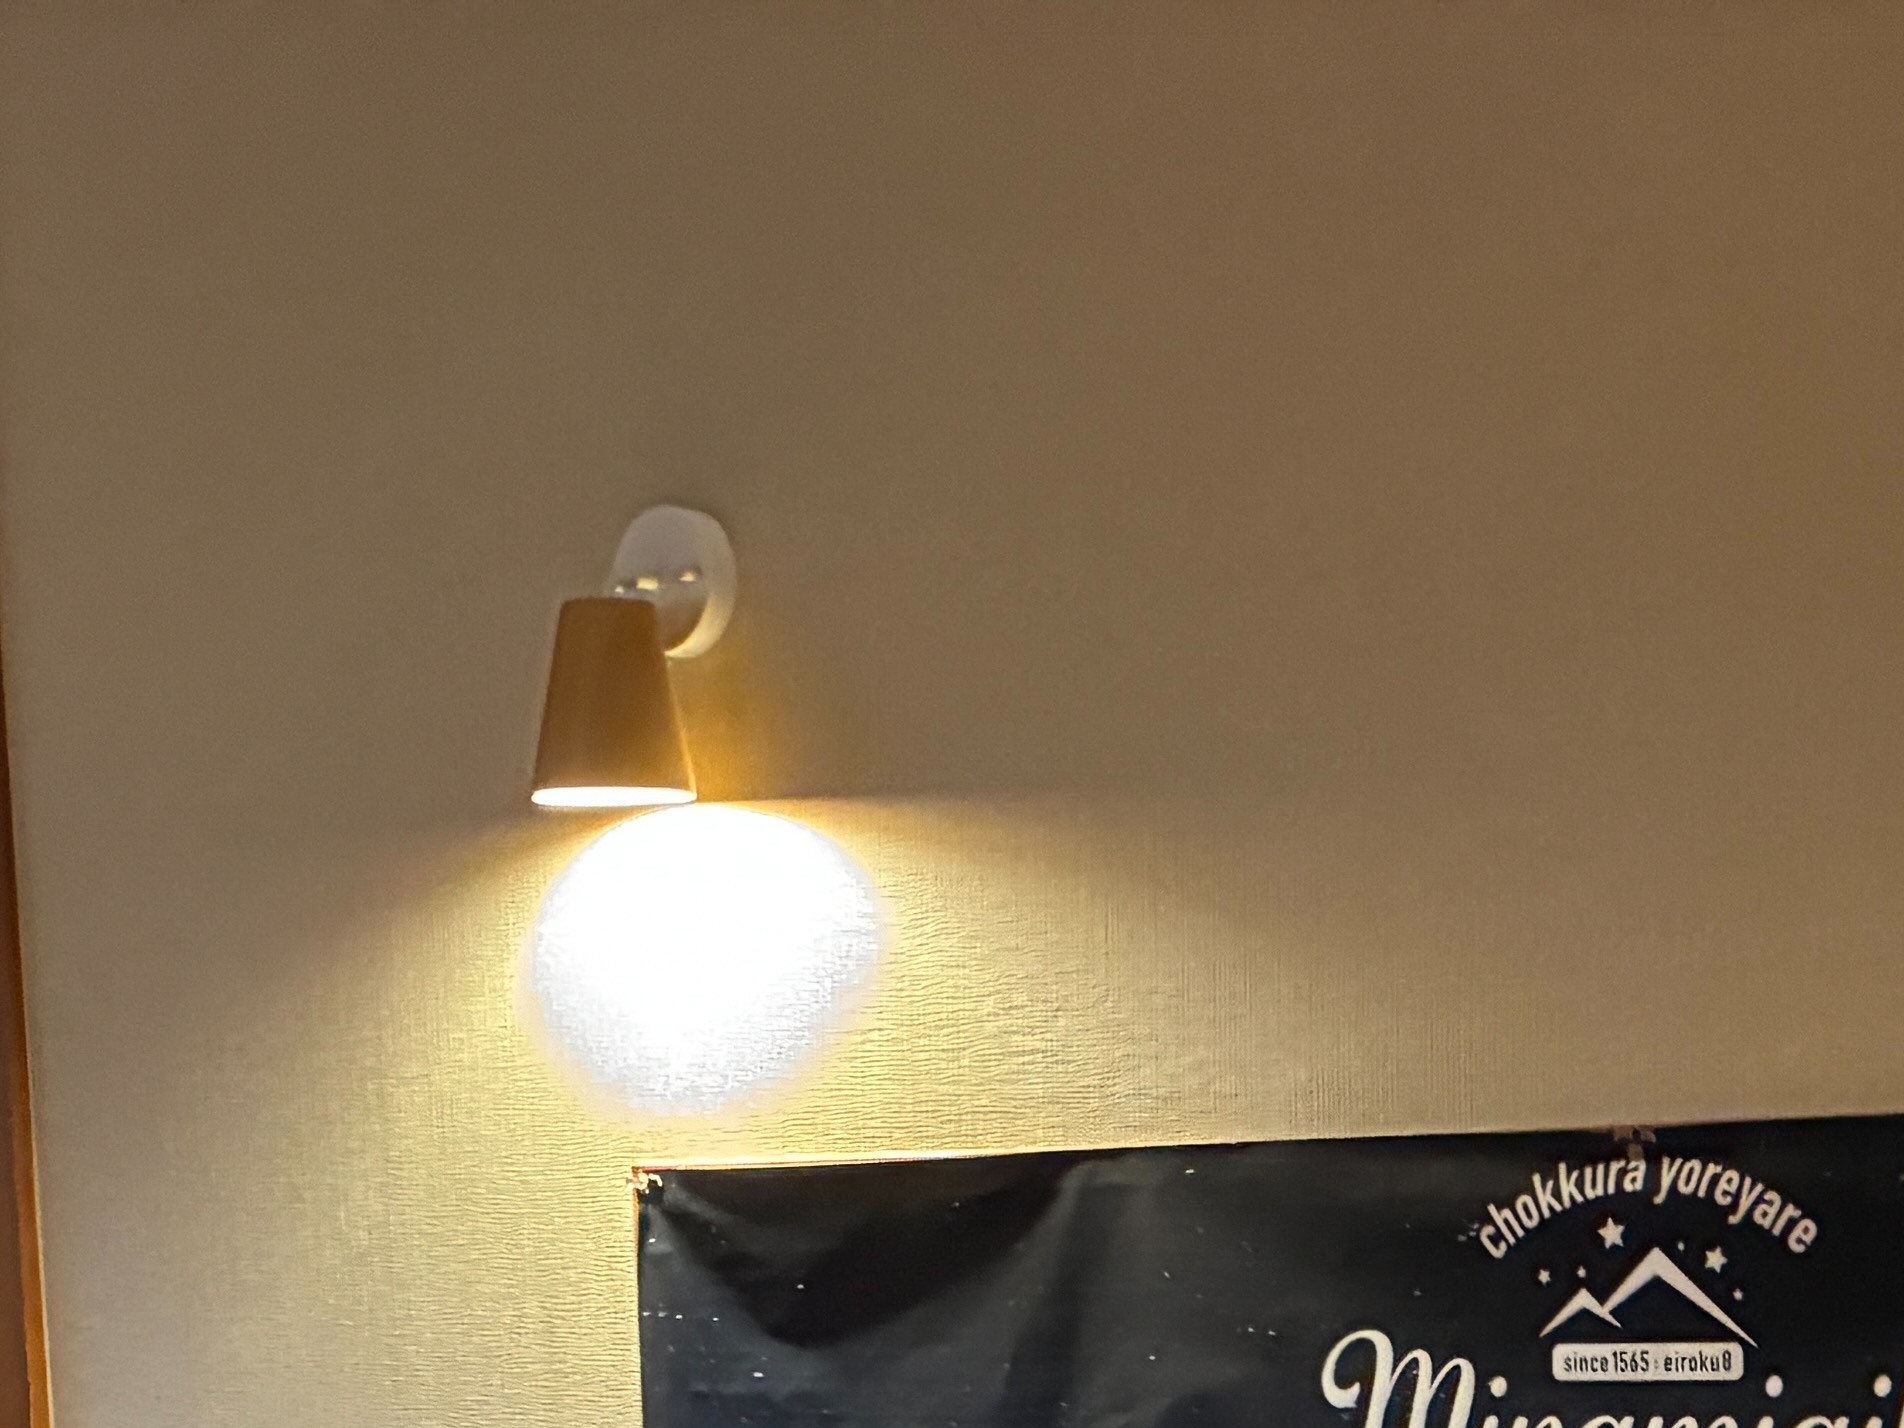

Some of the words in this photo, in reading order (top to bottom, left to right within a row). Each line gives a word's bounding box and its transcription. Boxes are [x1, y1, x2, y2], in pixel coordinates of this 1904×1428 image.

[1480, 1158, 1646, 1259] chokkura
[1653, 1156, 1818, 1253] yoreyare
[1563, 1351, 1609, 1373] since
[1612, 1349, 1650, 1373] 1565
